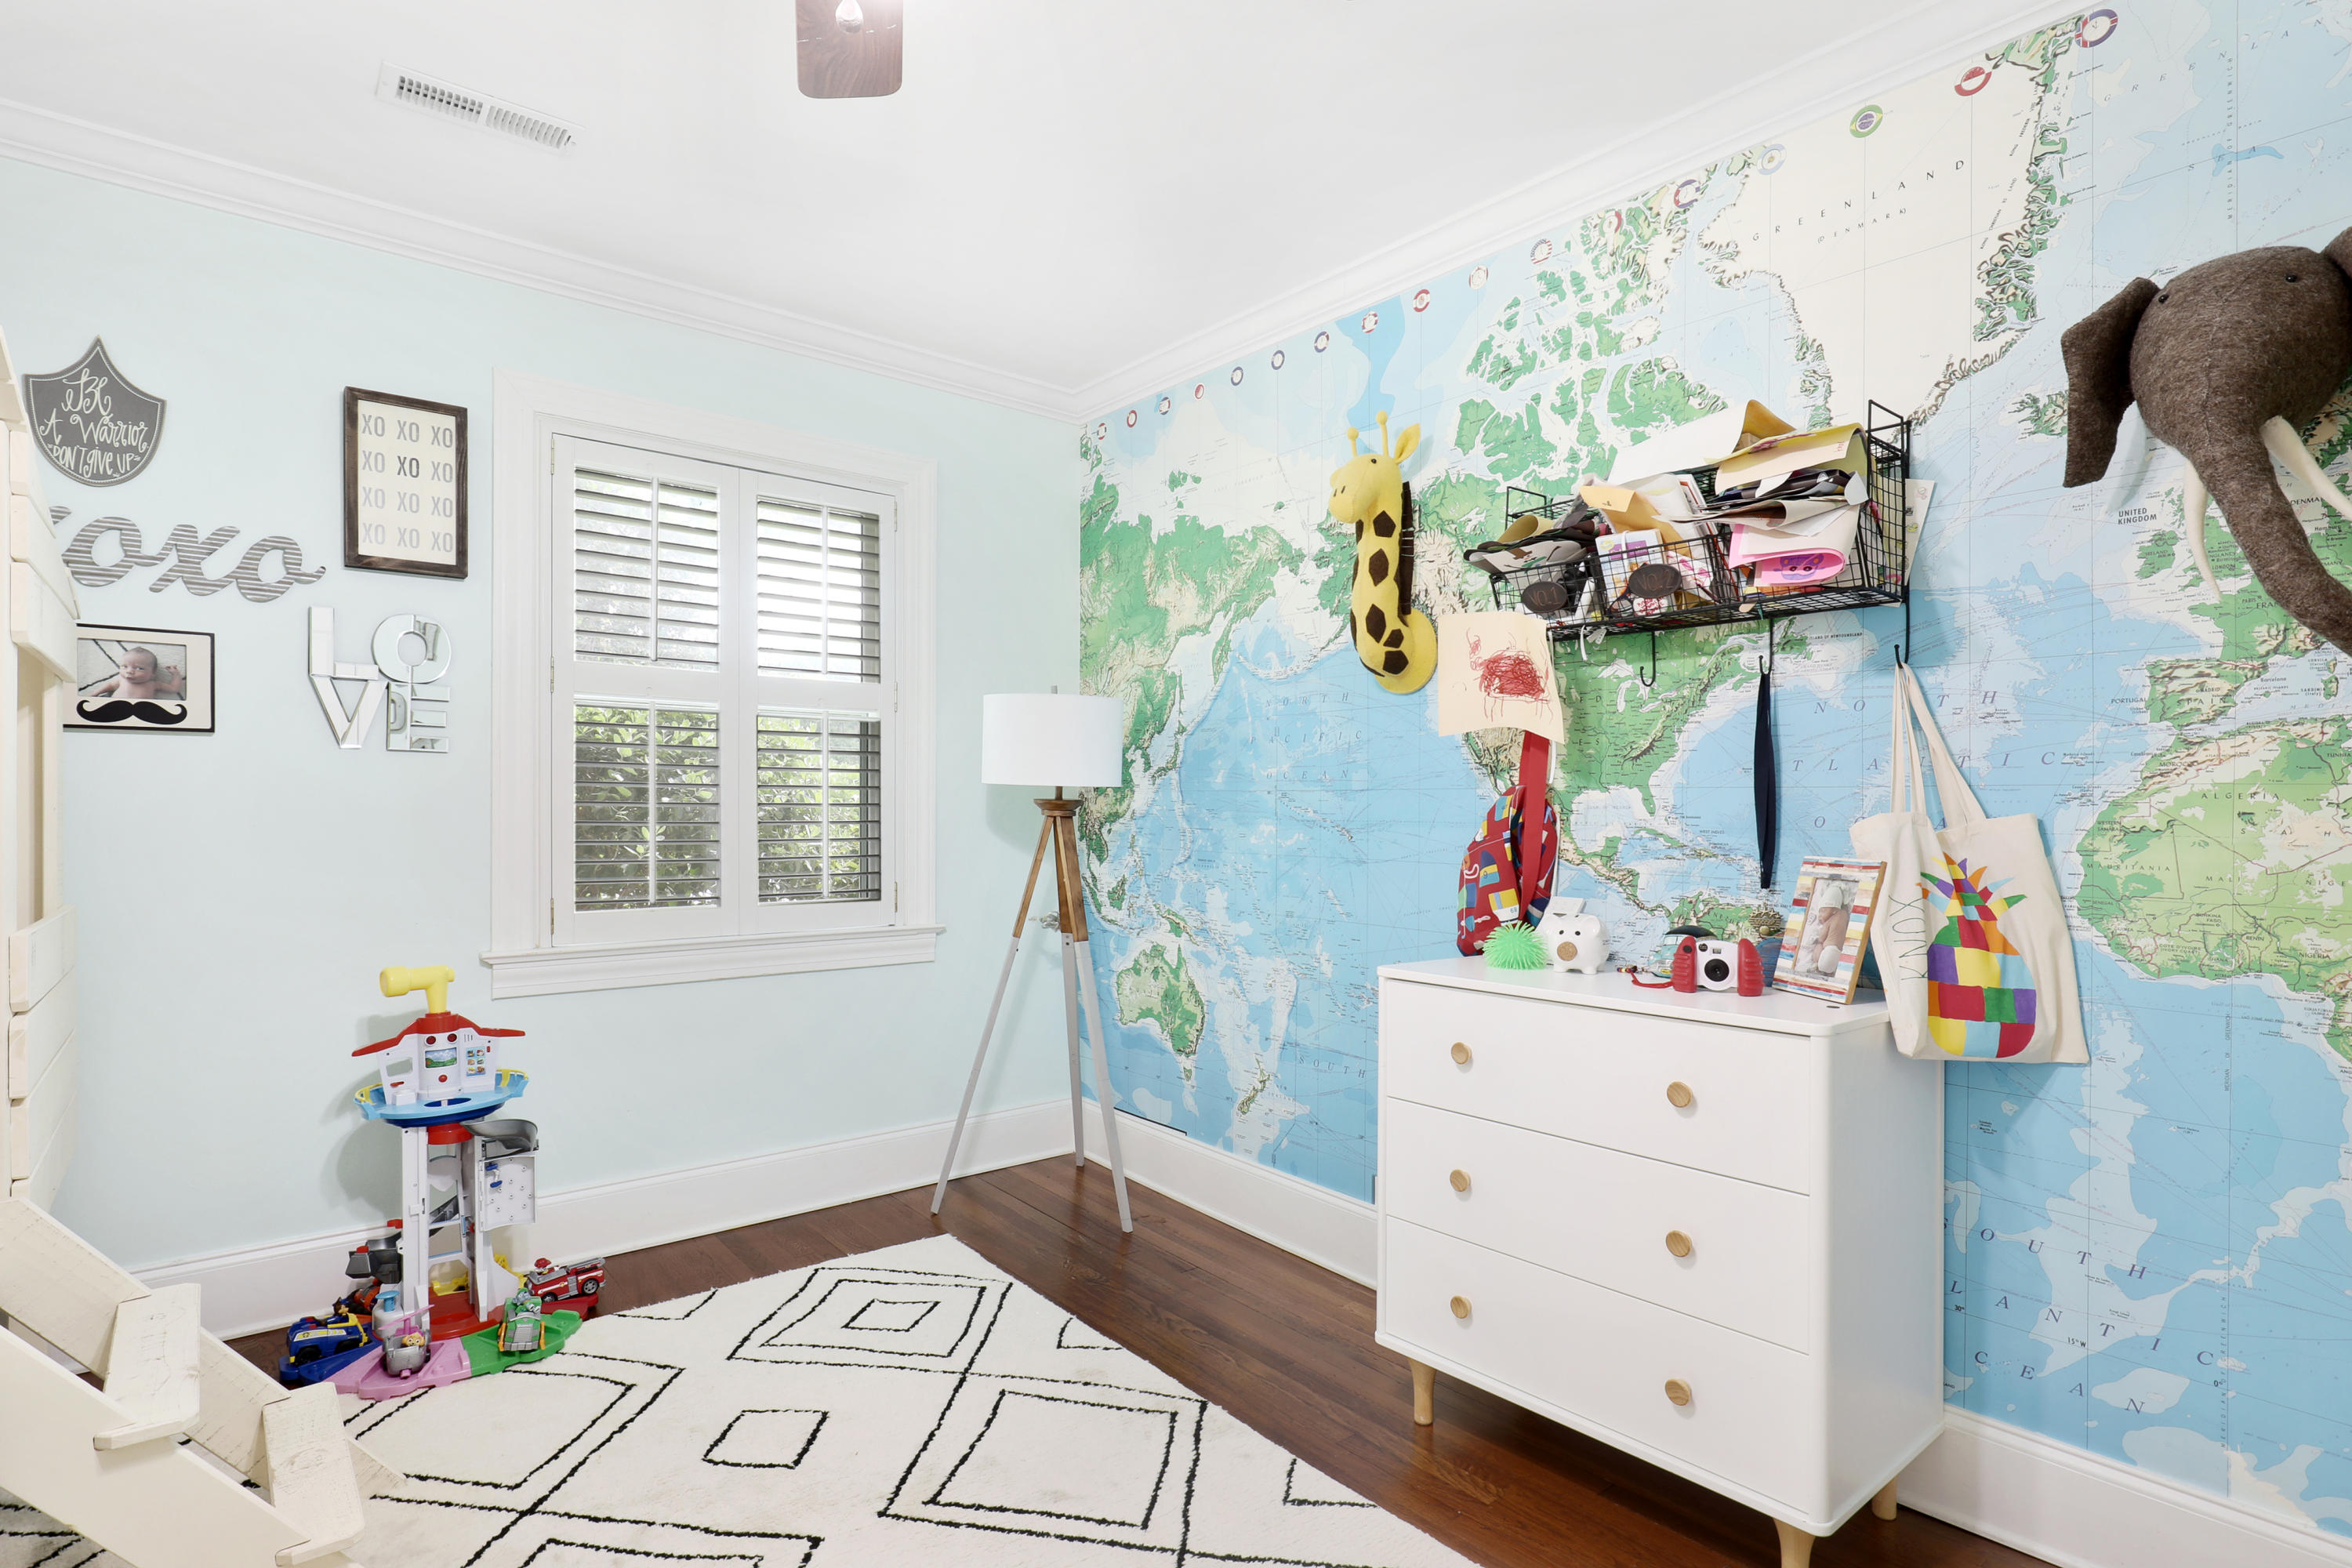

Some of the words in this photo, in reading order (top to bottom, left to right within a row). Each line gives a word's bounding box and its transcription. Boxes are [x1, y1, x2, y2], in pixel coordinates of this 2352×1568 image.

[1753, 159, 1964, 241] GREENLAND
[1817, 207, 1907, 244] (DENMARK)
[39, 408, 64, 445] A
[362, 414, 385, 437] XO
[397, 420, 419, 442] XO
[431, 426, 453, 448] XO
[118, 453, 135, 474] UP
[362, 450, 386, 473] XO
[397, 456, 419, 478] XO
[431, 461, 453, 483] XO
[362, 486, 386, 509] XO
[397, 492, 419, 514] XO
[431, 495, 453, 517] XO
[2118, 507, 2147, 517] UNITED
[2118, 514, 2157, 525] KINGDOM
[362, 523, 386, 545] XO
[397, 527, 419, 549] XO
[431, 532, 453, 553] XO
[1265, 691, 1349, 708] NORTH
[1813, 691, 1999, 715] NOTH
[2176, 698, 2227, 706] SPAIN
[1250, 729, 1363, 746] PACIFIC
[1266, 769, 1348, 780] OCEAN
[2201, 792, 2280, 800] ALGERIA
[2087, 863, 2171, 872] MAURITANIA
[1888, 895, 1929, 981] KNOX
[1298, 1055, 1367, 1080] SOUTH
